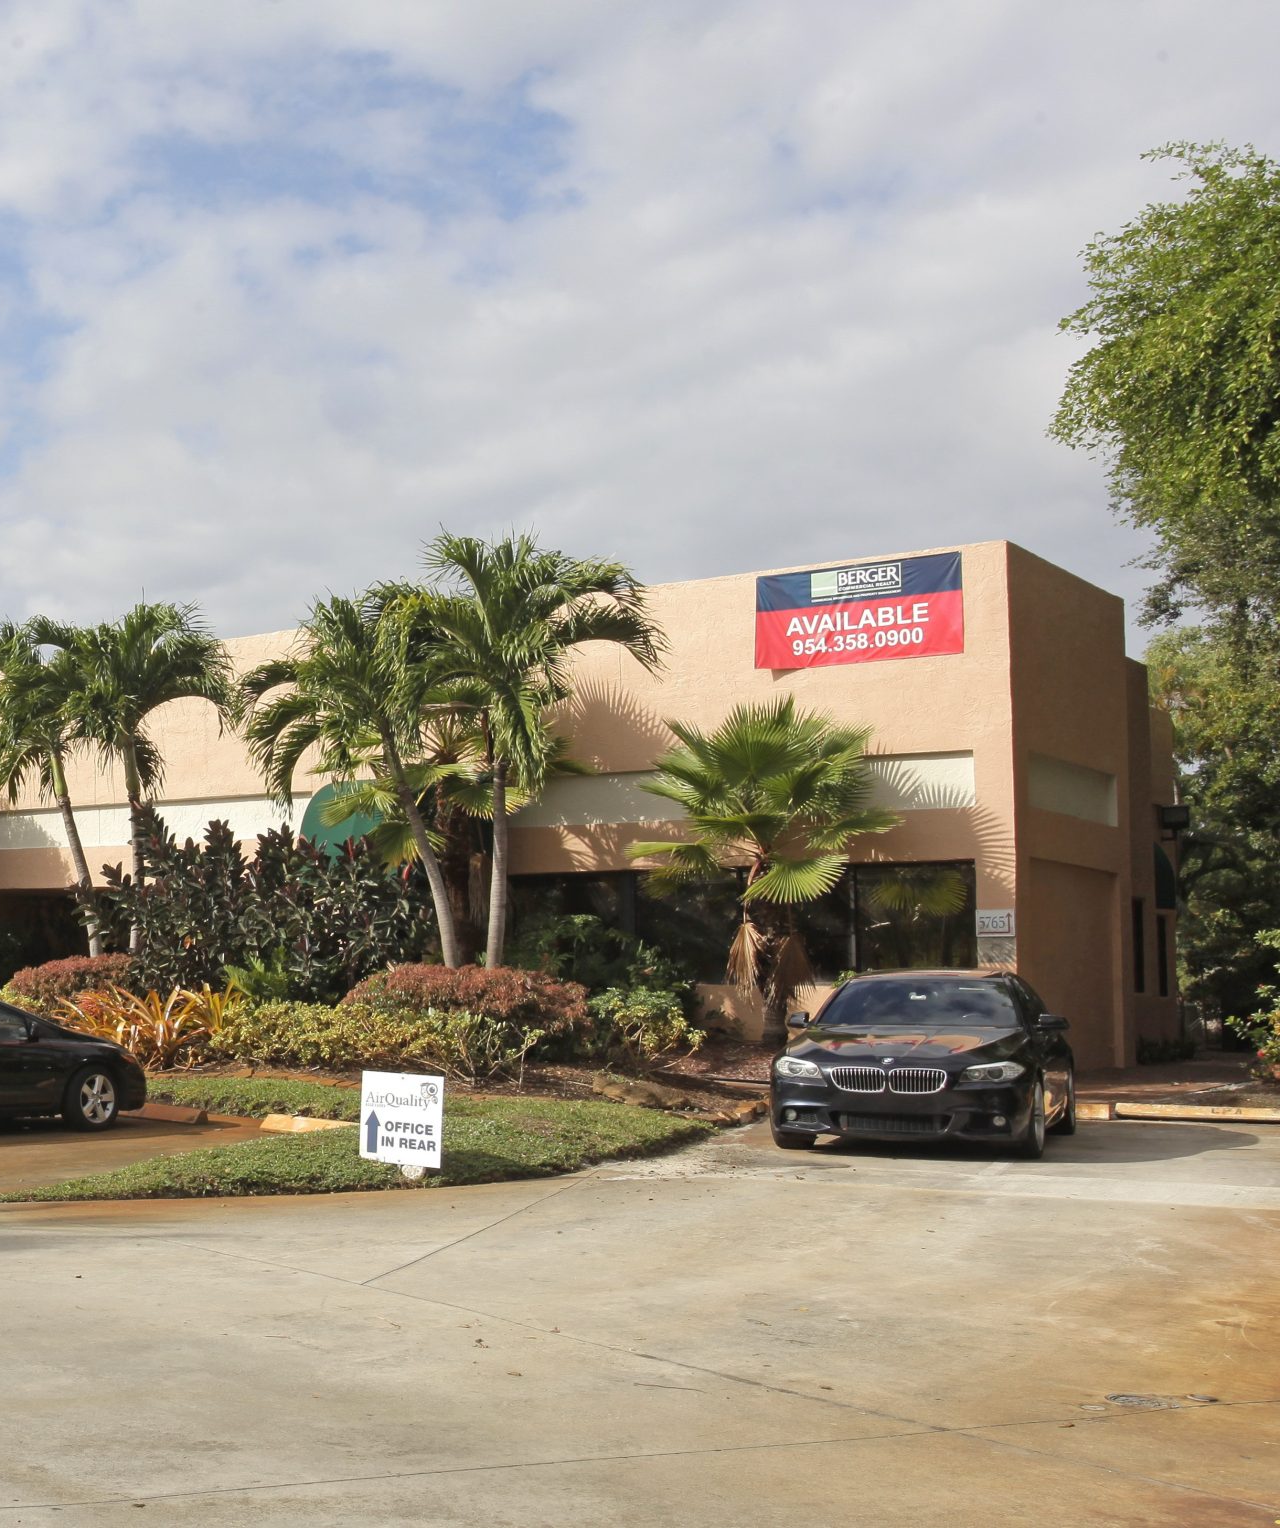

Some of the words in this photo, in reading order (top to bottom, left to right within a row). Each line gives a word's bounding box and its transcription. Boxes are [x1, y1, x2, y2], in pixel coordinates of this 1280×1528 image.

[838, 566, 900, 587] BERGER
[838, 583, 875, 592] COMMERCIAL
[875, 580, 896, 588] REALTY
[786, 602, 929, 636] AVAILABLE
[792, 627, 924, 656] 954.358.0900
[979, 916, 1006, 929] 5765
[365, 1091, 431, 1111] AirQuality
[384, 1120, 434, 1136] OFFICE
[381, 1135, 395, 1148] IN
[399, 1137, 437, 1152] REAR
